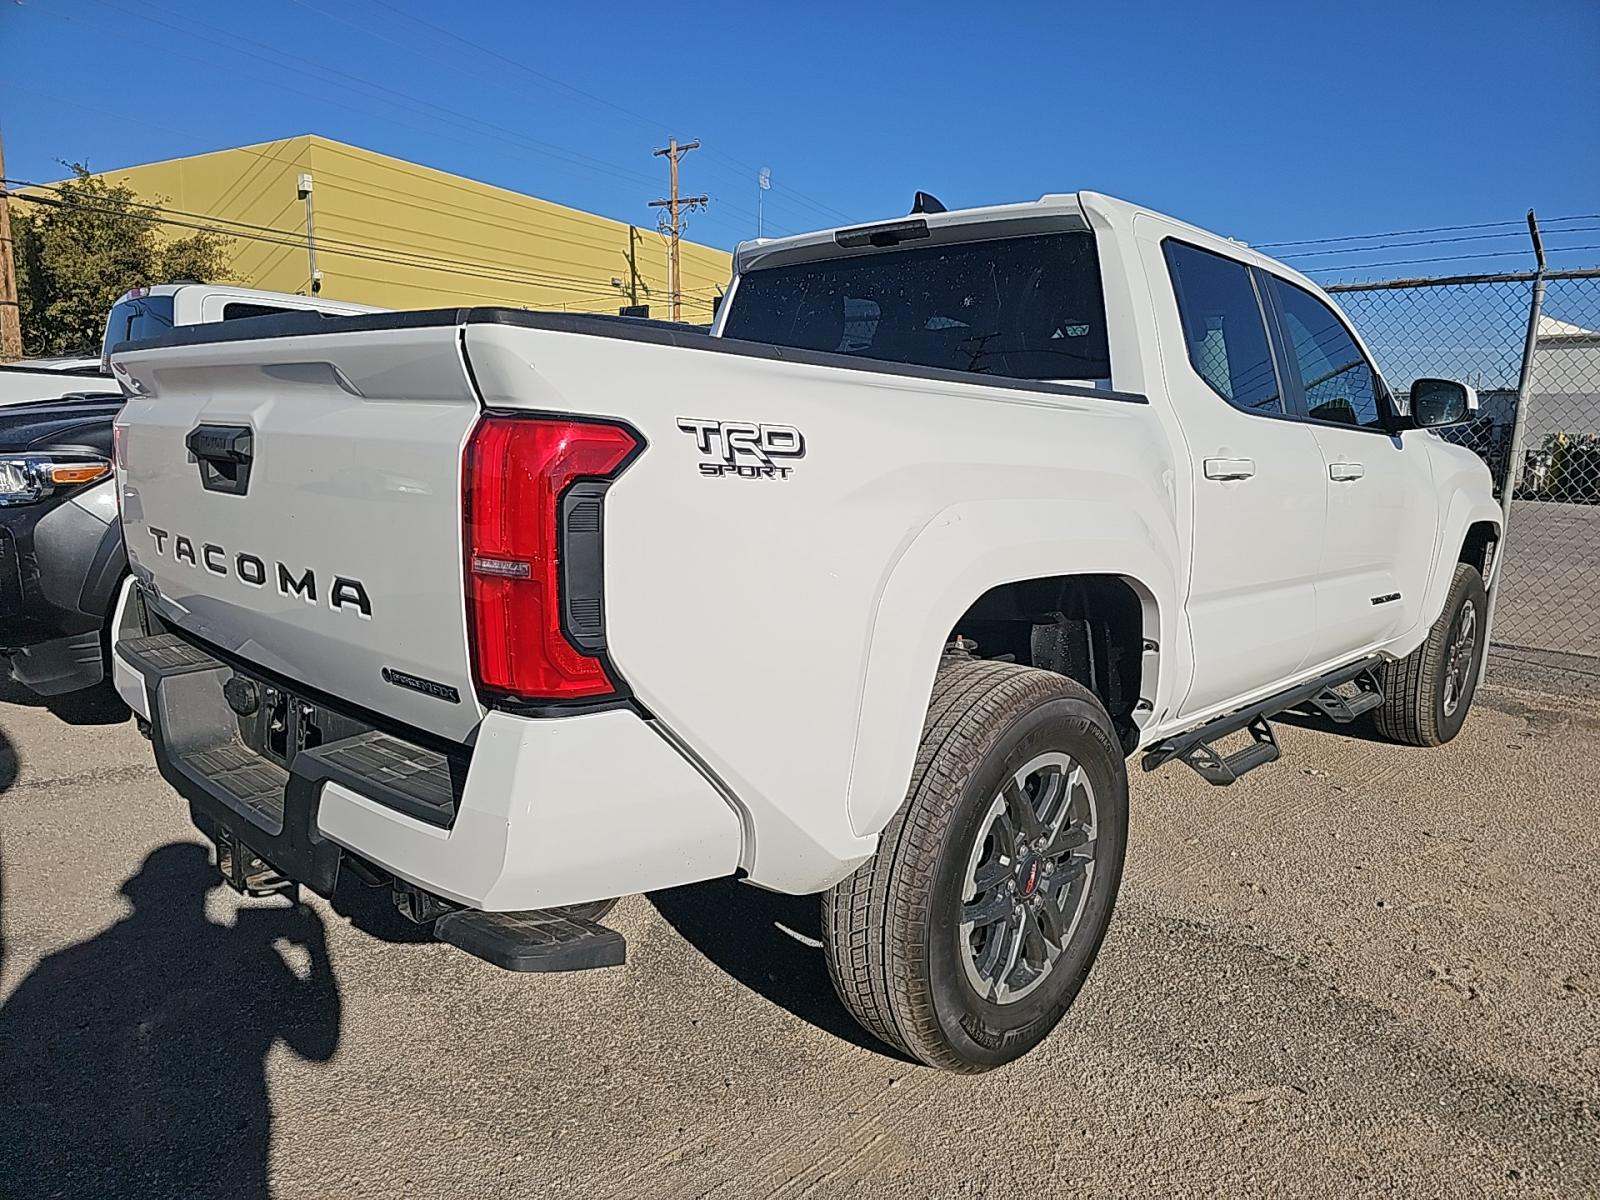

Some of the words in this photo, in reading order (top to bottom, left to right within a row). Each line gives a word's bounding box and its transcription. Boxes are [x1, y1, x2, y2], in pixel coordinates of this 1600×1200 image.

[676, 417, 806, 467] TRD
[699, 463, 793, 480] SPORT
[148, 525, 372, 620] TACOMA
